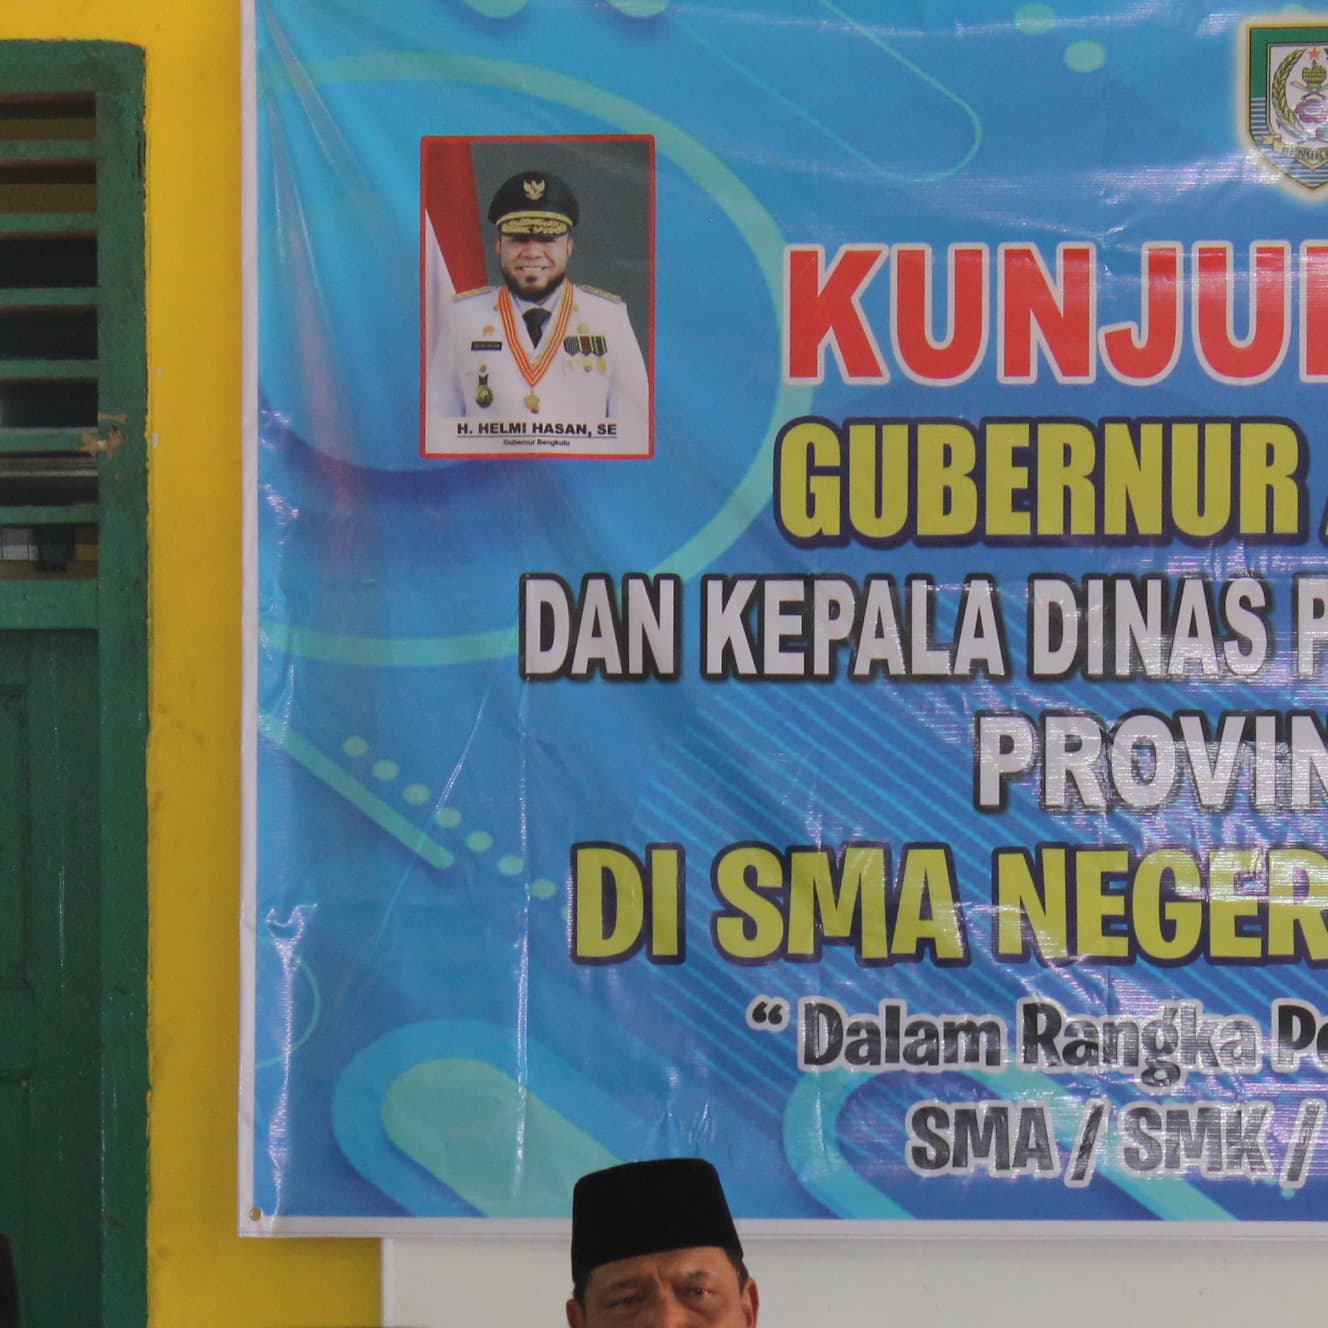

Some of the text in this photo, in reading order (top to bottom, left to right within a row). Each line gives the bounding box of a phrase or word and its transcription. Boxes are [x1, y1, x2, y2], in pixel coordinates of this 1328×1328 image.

[457, 422, 617, 438] H. HELMI HASAN, SE
[778, 419, 1302, 541] GUBERNUR
[522, 576, 676, 677] DAN
[702, 576, 1007, 678] KEPALA
[1032, 575, 1268, 678] DINAS
[574, 846, 682, 961] DI
[713, 845, 967, 962] SMA
[801, 1001, 1003, 1067] Dalam
[1020, 1000, 1261, 1088] Rangka
[909, 1105, 1055, 1173] SMA
[1121, 1104, 1275, 1173] SMK
